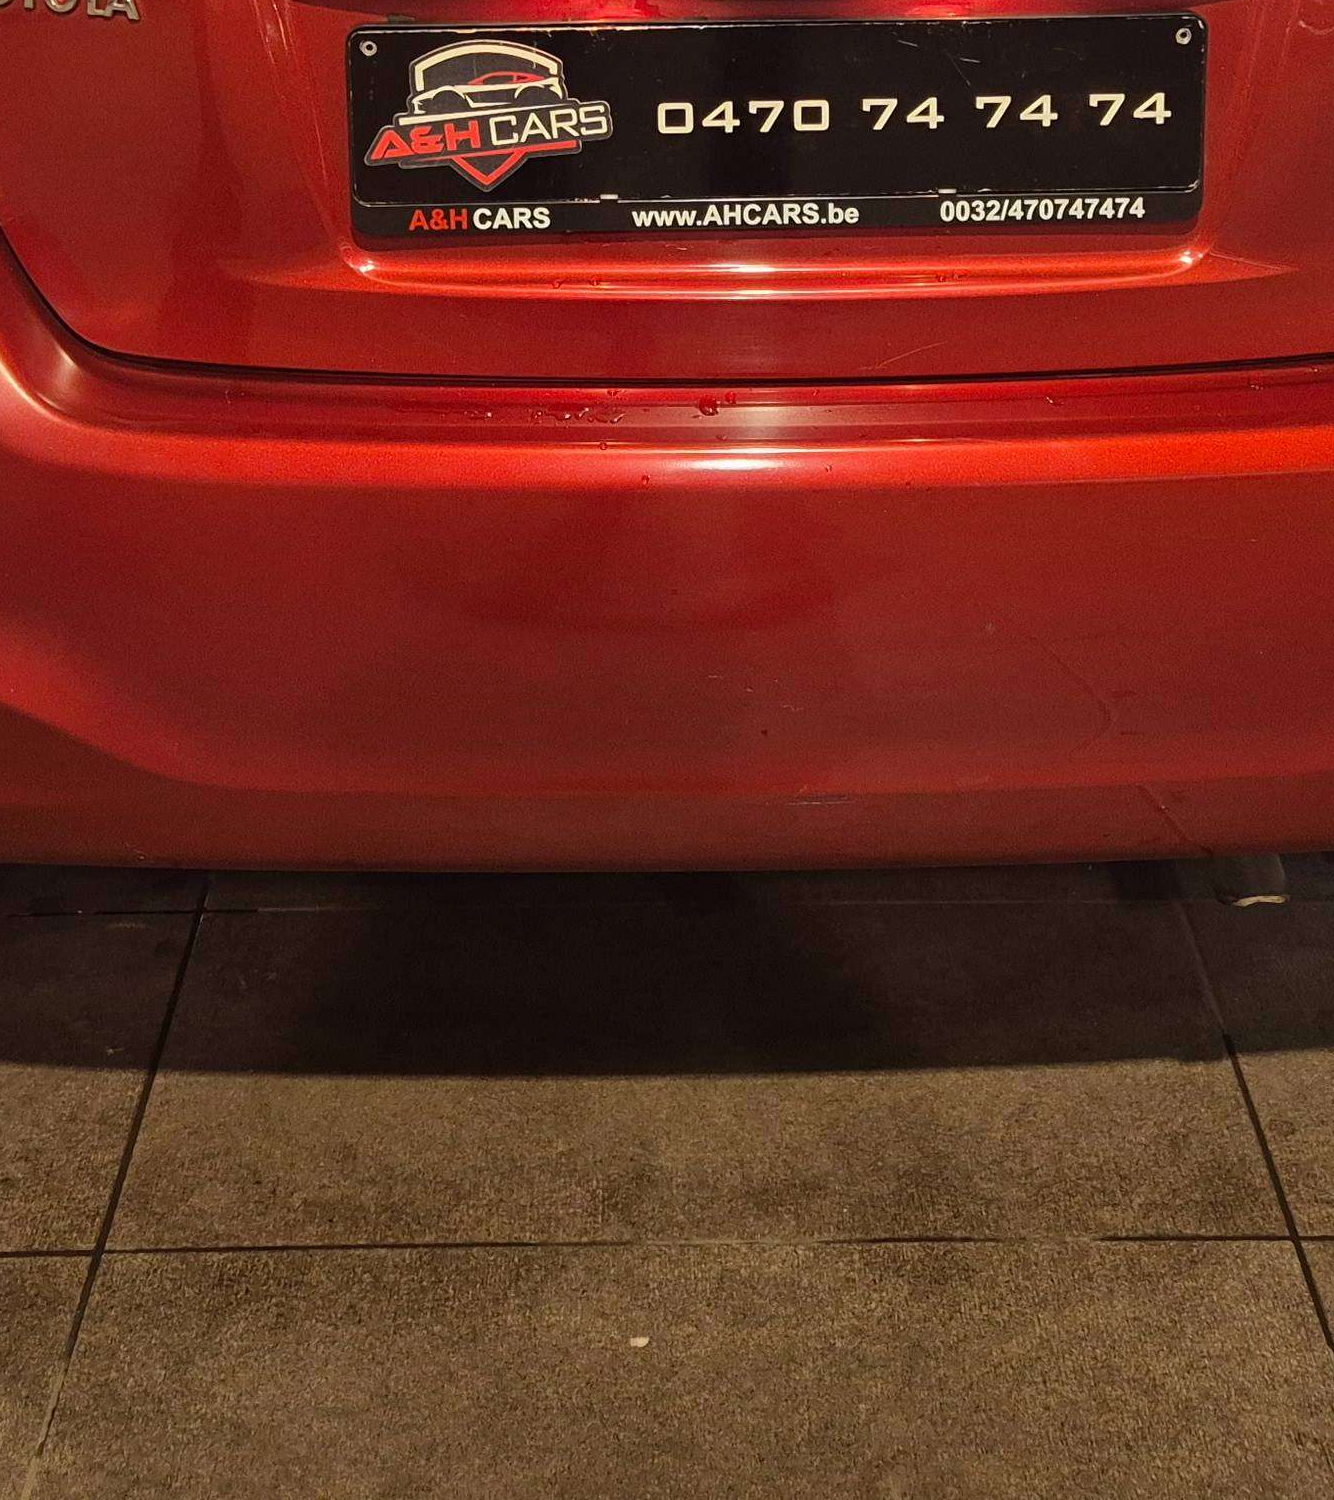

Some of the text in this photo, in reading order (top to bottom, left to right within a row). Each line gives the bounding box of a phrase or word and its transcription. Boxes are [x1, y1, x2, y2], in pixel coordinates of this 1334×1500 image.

[657, 92, 1172, 134] 0470 74 74 74
[370, 104, 610, 161] A&H CARS
[409, 207, 551, 231] A&H CARS
[632, 203, 860, 227] www.AHCARS.be
[939, 198, 1145, 222] 0032/470747474
